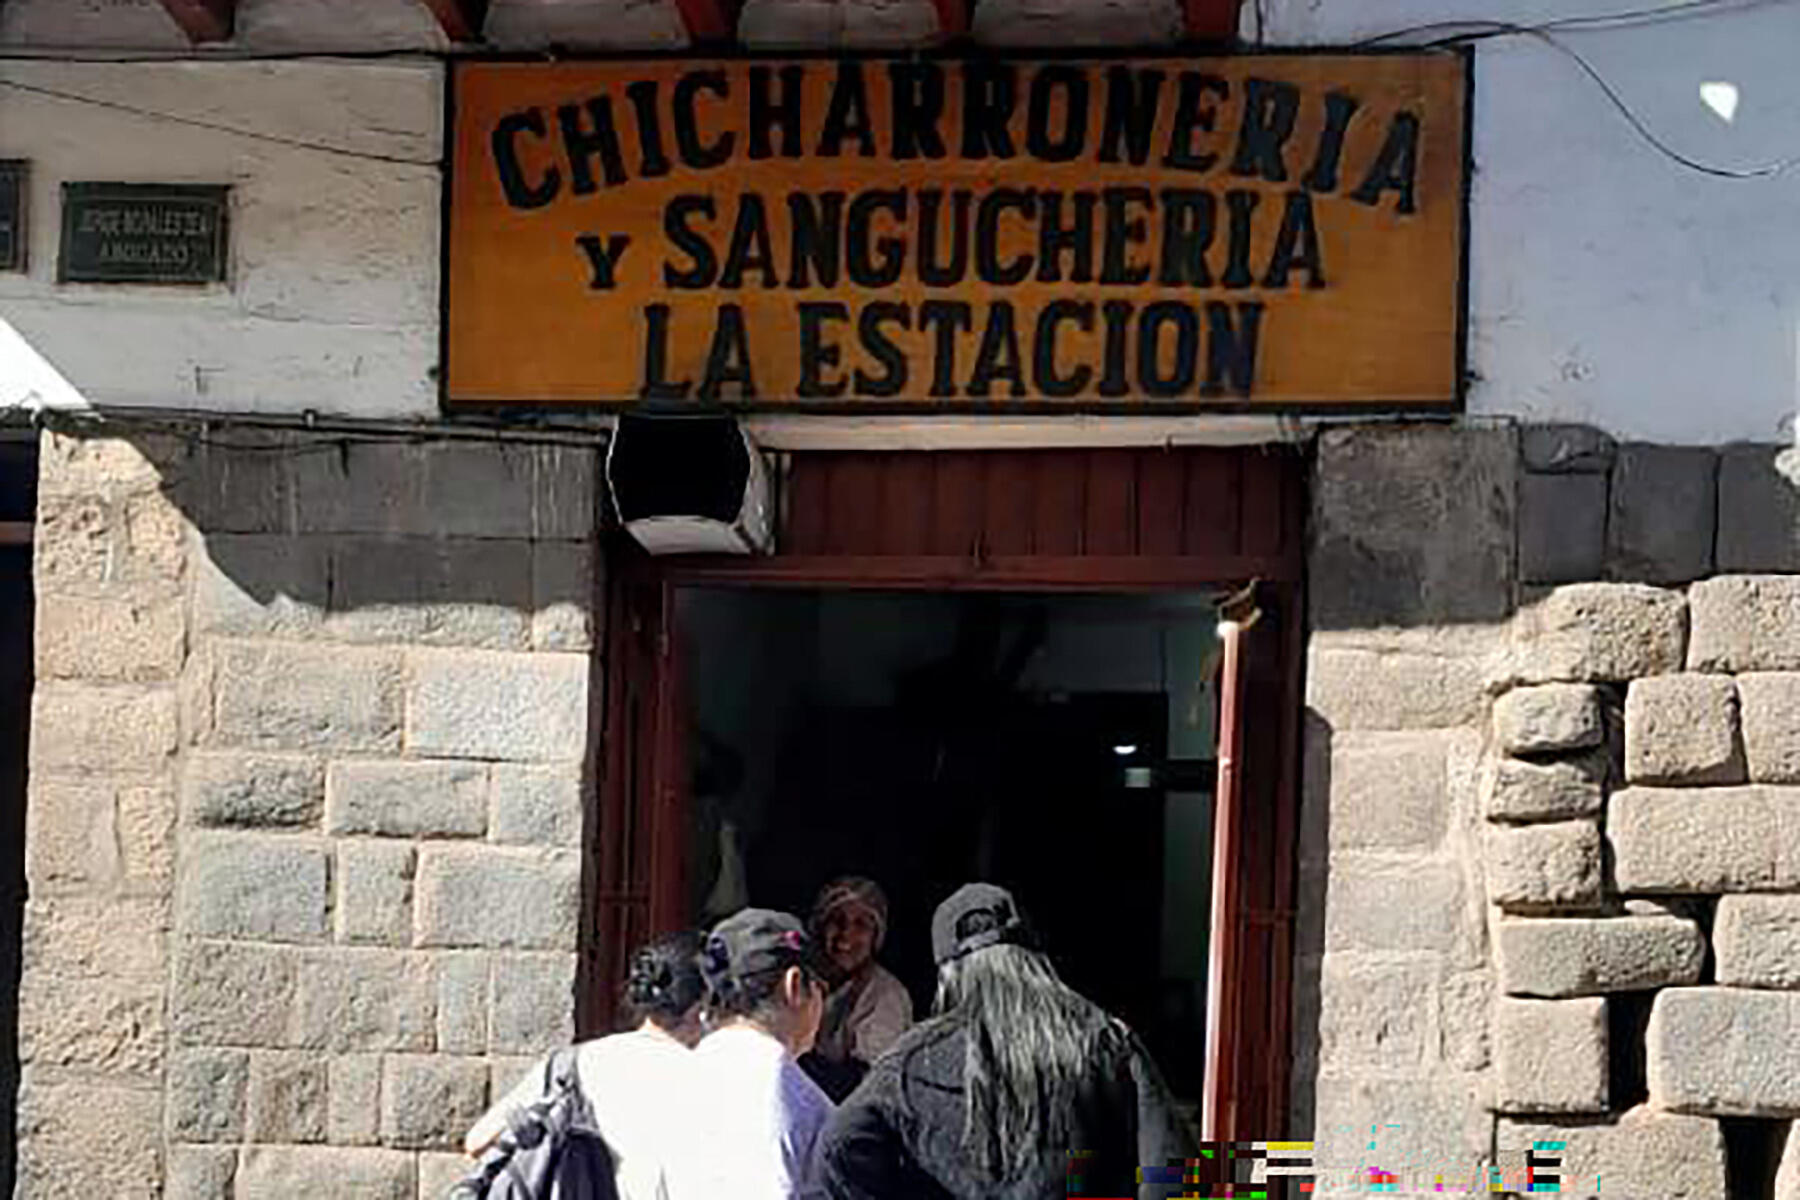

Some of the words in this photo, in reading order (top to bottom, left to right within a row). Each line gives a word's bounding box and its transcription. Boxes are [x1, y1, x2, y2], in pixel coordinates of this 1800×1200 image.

[490, 62, 1422, 213] CHICHARRONERIA
[574, 234, 631, 290] Y
[663, 188, 1327, 291] SANGUCHERIA
[643, 302, 754, 398] LA
[795, 298, 1264, 400] ESTACION
